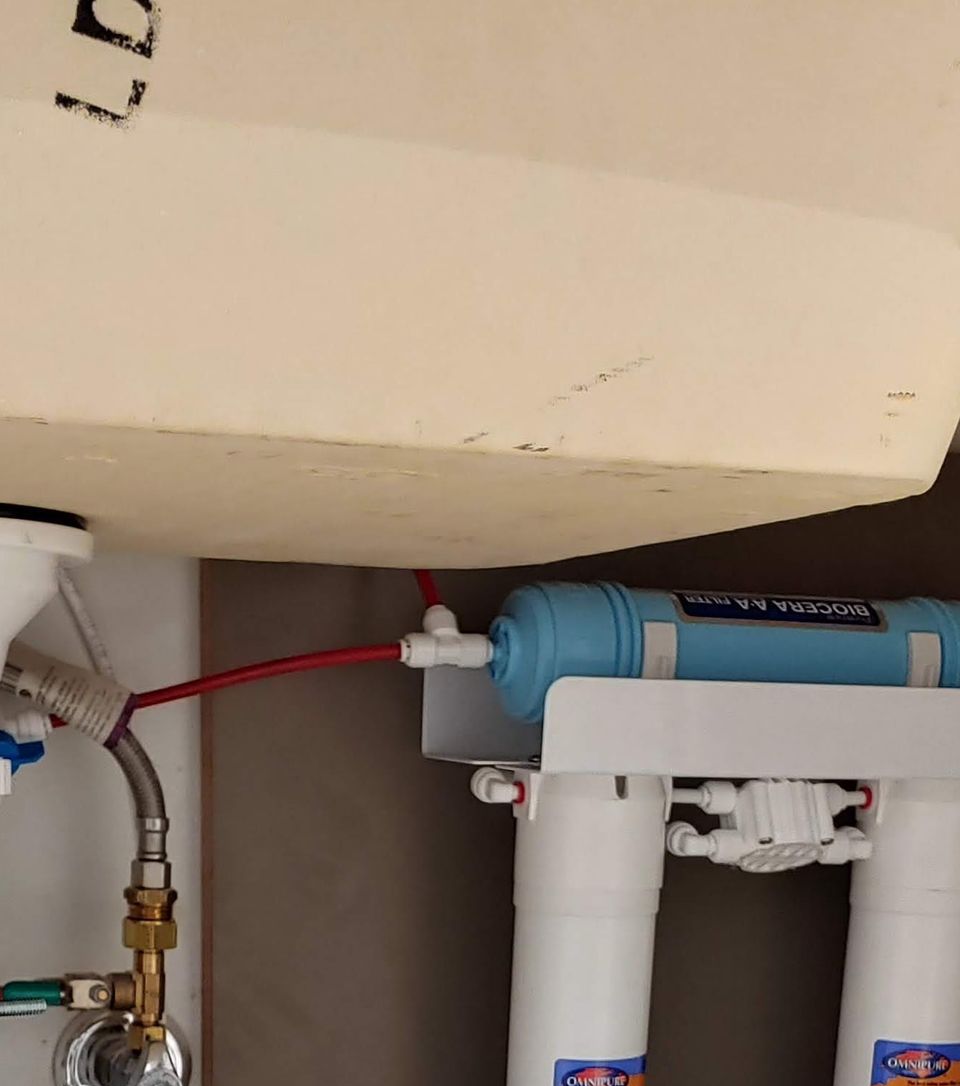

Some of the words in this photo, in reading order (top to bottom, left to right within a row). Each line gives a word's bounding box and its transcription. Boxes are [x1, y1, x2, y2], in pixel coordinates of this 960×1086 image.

[684, 594, 732, 606] FILTER
[772, 598, 871, 616] BIOCERA
[887, 1057, 948, 1071] OMNIPURE
